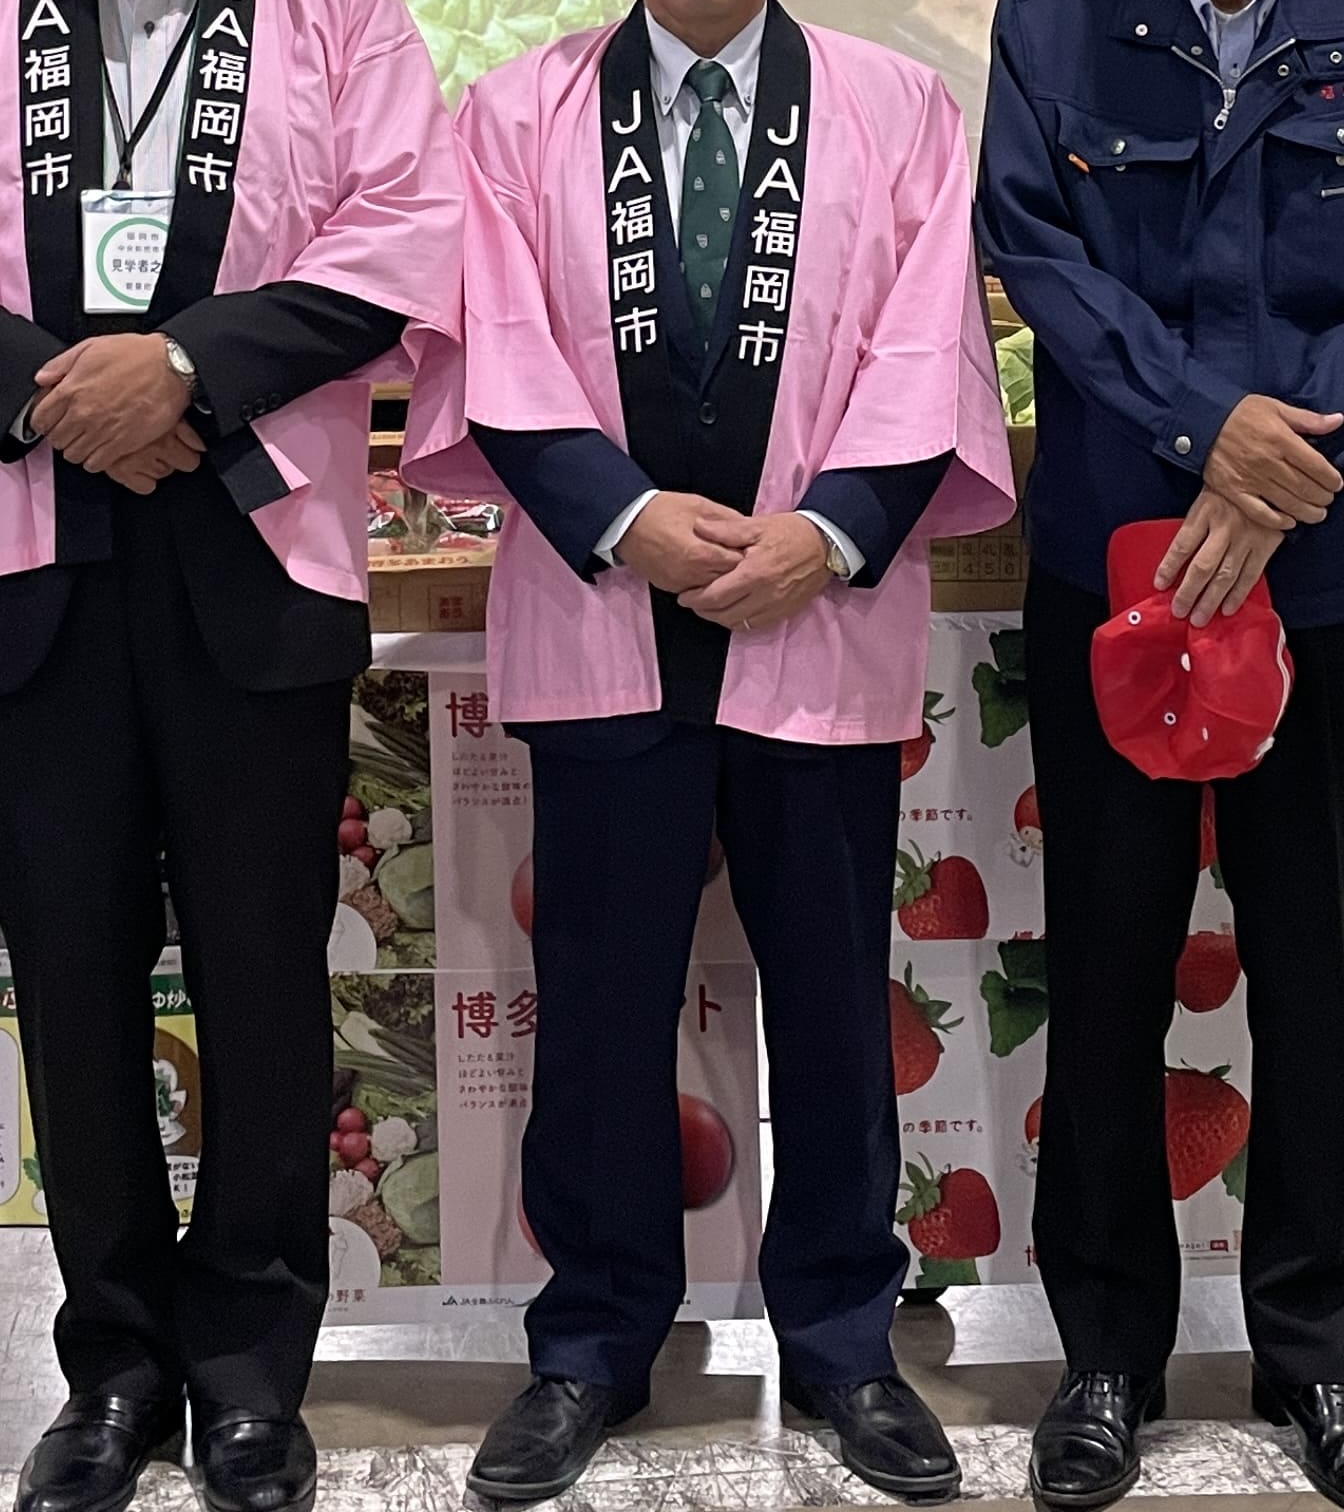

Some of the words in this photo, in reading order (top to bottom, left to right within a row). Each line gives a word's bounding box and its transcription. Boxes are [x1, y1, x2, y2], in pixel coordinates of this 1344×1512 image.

[608, 89, 658, 353] JA福岡市
[738, 104, 801, 367] JA福岡市
[446, 692, 494, 738] 博
[452, 990, 537, 1038] 博多
